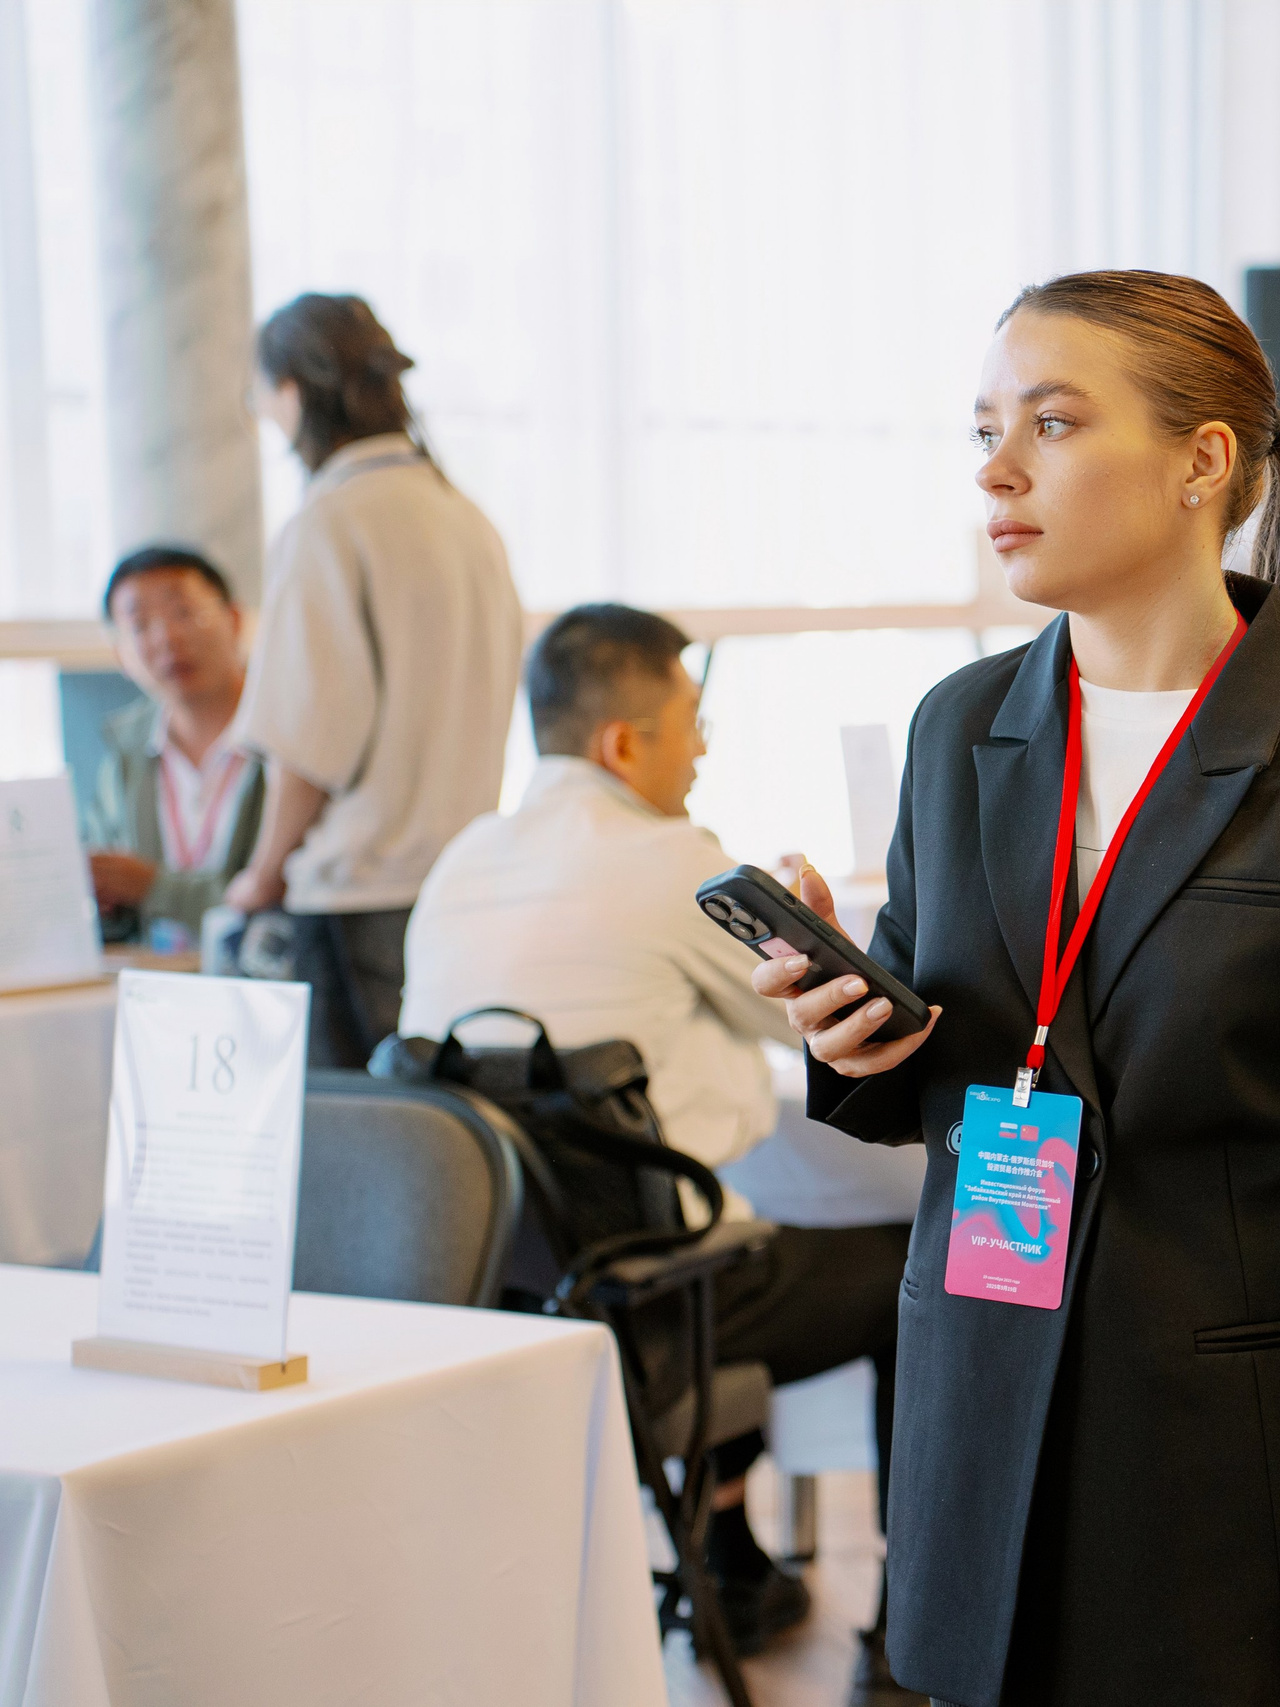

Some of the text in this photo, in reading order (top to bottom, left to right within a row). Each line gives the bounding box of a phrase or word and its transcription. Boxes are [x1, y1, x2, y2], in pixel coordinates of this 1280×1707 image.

[185, 1033, 237, 1095] 18
[980, 1179, 1046, 1195] Инвестиционный форум
[971, 1194, 988, 1202] район
[1008, 1191, 1022, 1199] край
[1026, 1193, 1061, 1204] Автономный
[971, 1235, 1043, 1255] VIP-УЧАСТНИК
